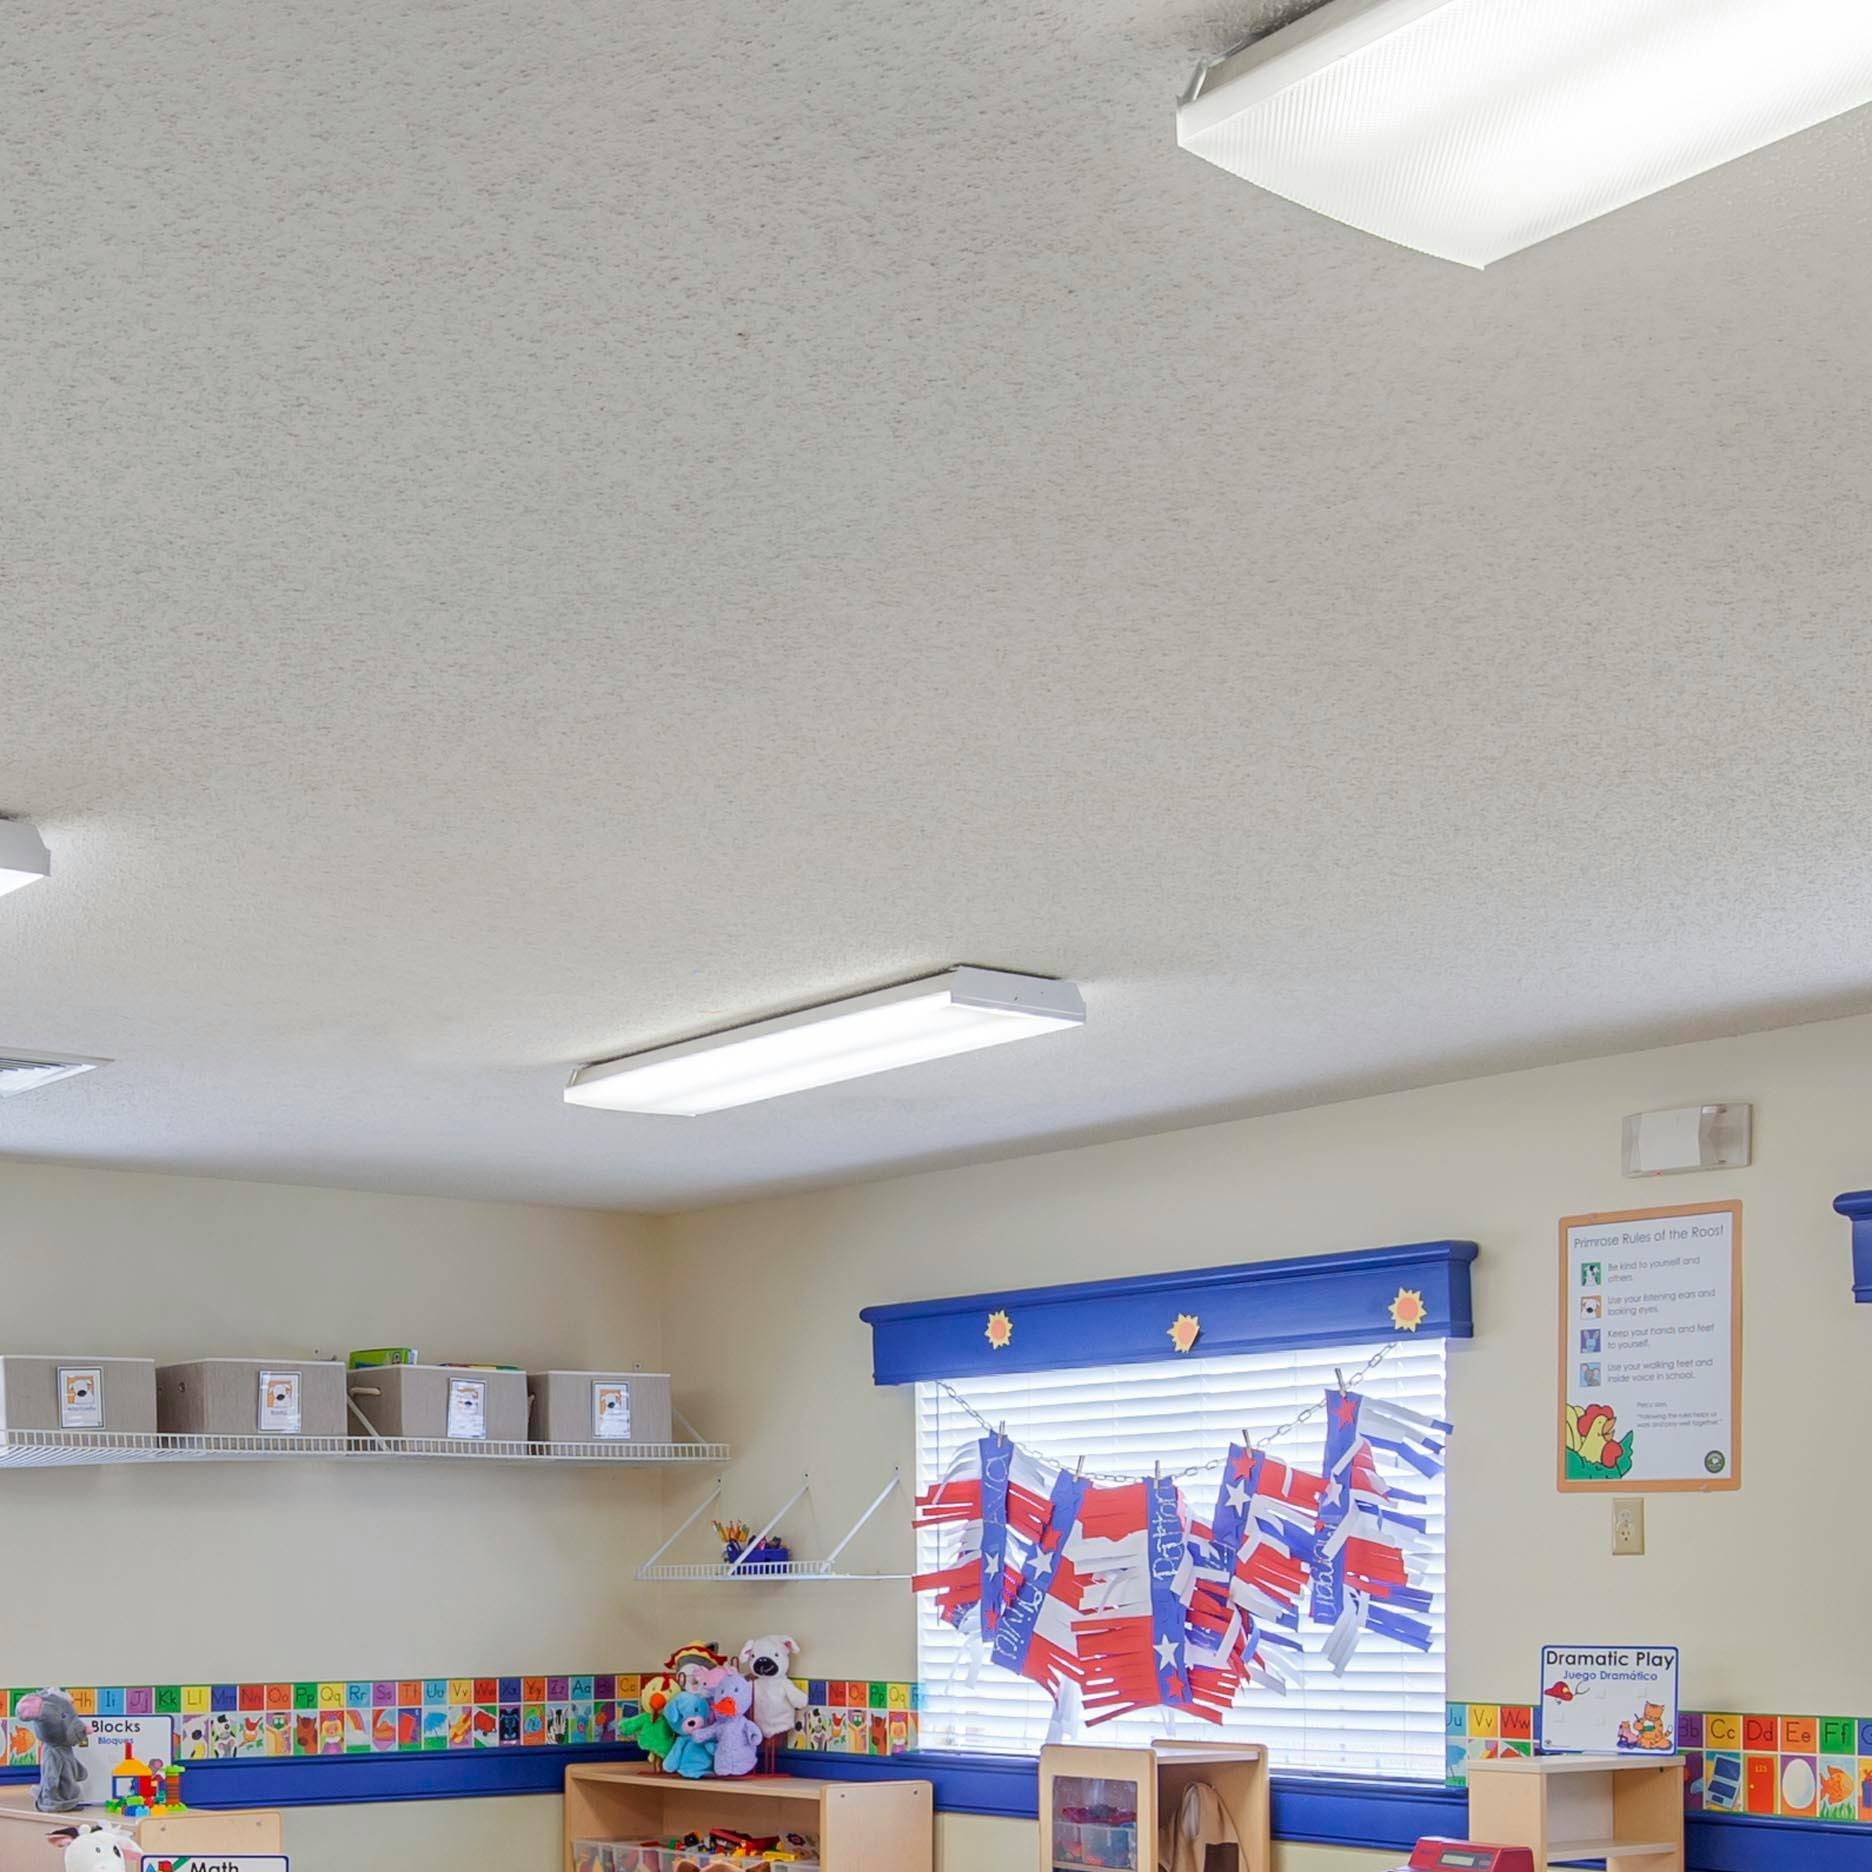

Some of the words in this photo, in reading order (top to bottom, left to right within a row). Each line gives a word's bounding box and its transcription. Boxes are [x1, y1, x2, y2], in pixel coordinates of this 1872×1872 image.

[1574, 1237, 1619, 1248] Primrose
[1622, 1232, 1651, 1244] Rules
[1654, 1230, 1666, 1242] of
[1669, 1229, 1688, 1240] the
[1691, 1225, 1724, 1237] Roost
[1608, 1329, 1628, 1338] Keep
[1678, 1325, 1695, 1333] and
[1546, 1650, 1629, 1667] Dramatic
[1636, 1652, 1675, 1671] Play
[1563, 1671, 1597, 1682] Juego
[1600, 1670, 1658, 1682] Dramático
[158, 1688, 177, 1706] Kk
[267, 1687, 289, 1704] Oo
[296, 1687, 315, 1708] Pp
[320, 1686, 342, 1707] Qq
[349, 1685, 367, 1701] Rr
[427, 1684, 445, 1699] Uu
[572, 1680, 591, 1694] Aa
[92, 1720, 141, 1734] Blocks
[1474, 1709, 1492, 1728] Vv
[1502, 1709, 1531, 1730] Ww
[98, 1736, 134, 1745] Bloques
[1710, 1718, 1735, 1740] Cc
[1746, 1719, 1773, 1742] Dd
[1786, 1721, 1811, 1743] Ee
[1823, 1722, 1849, 1745] Ff
